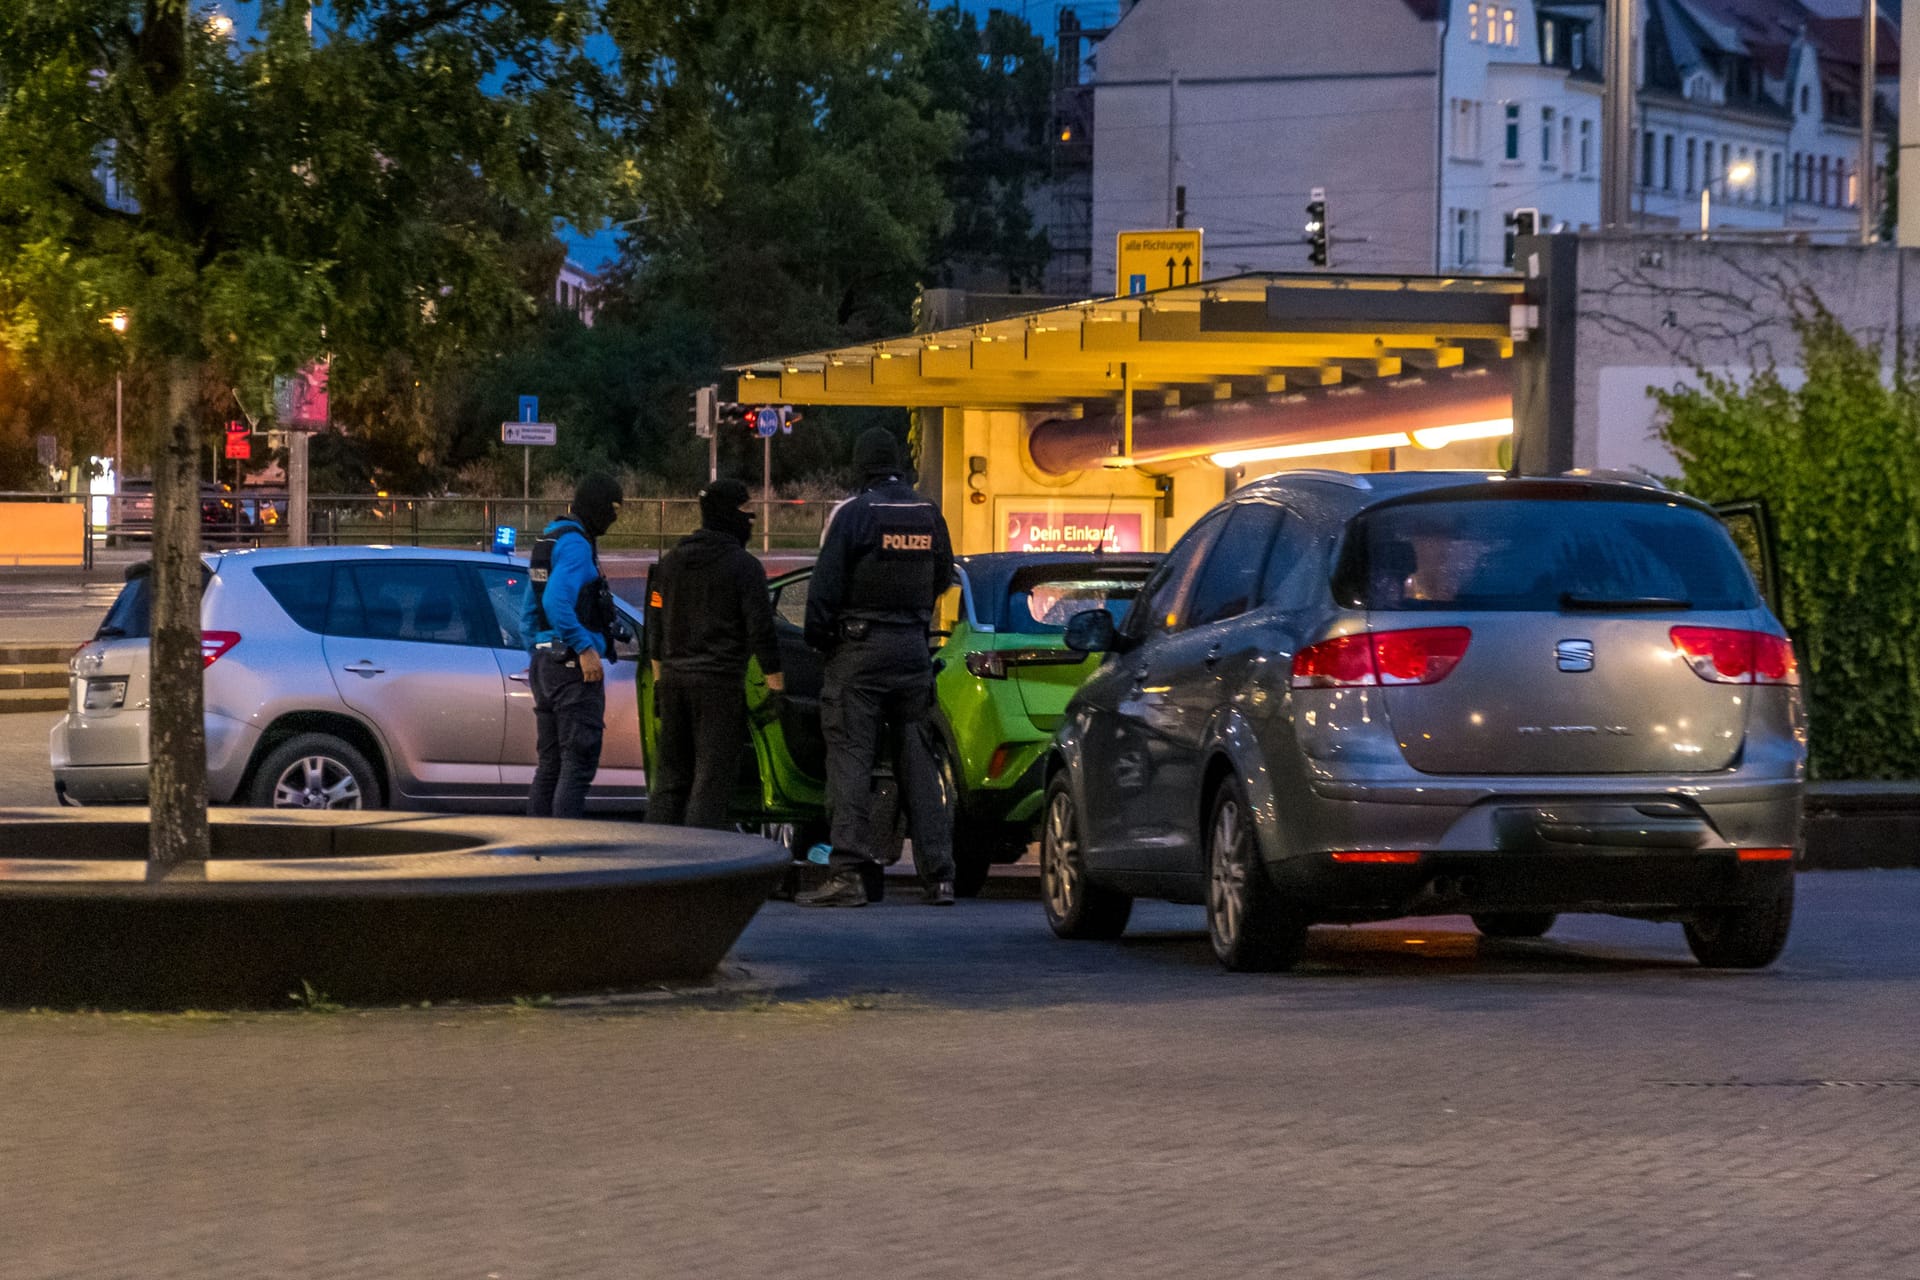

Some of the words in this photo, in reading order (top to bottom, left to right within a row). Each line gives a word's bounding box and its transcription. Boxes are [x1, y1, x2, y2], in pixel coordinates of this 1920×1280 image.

[1125, 240, 1141, 251] alle
[1143, 240, 1195, 253] Richtungen
[1030, 525, 1061, 541] Dein
[882, 534, 932, 550] POLIZEI
